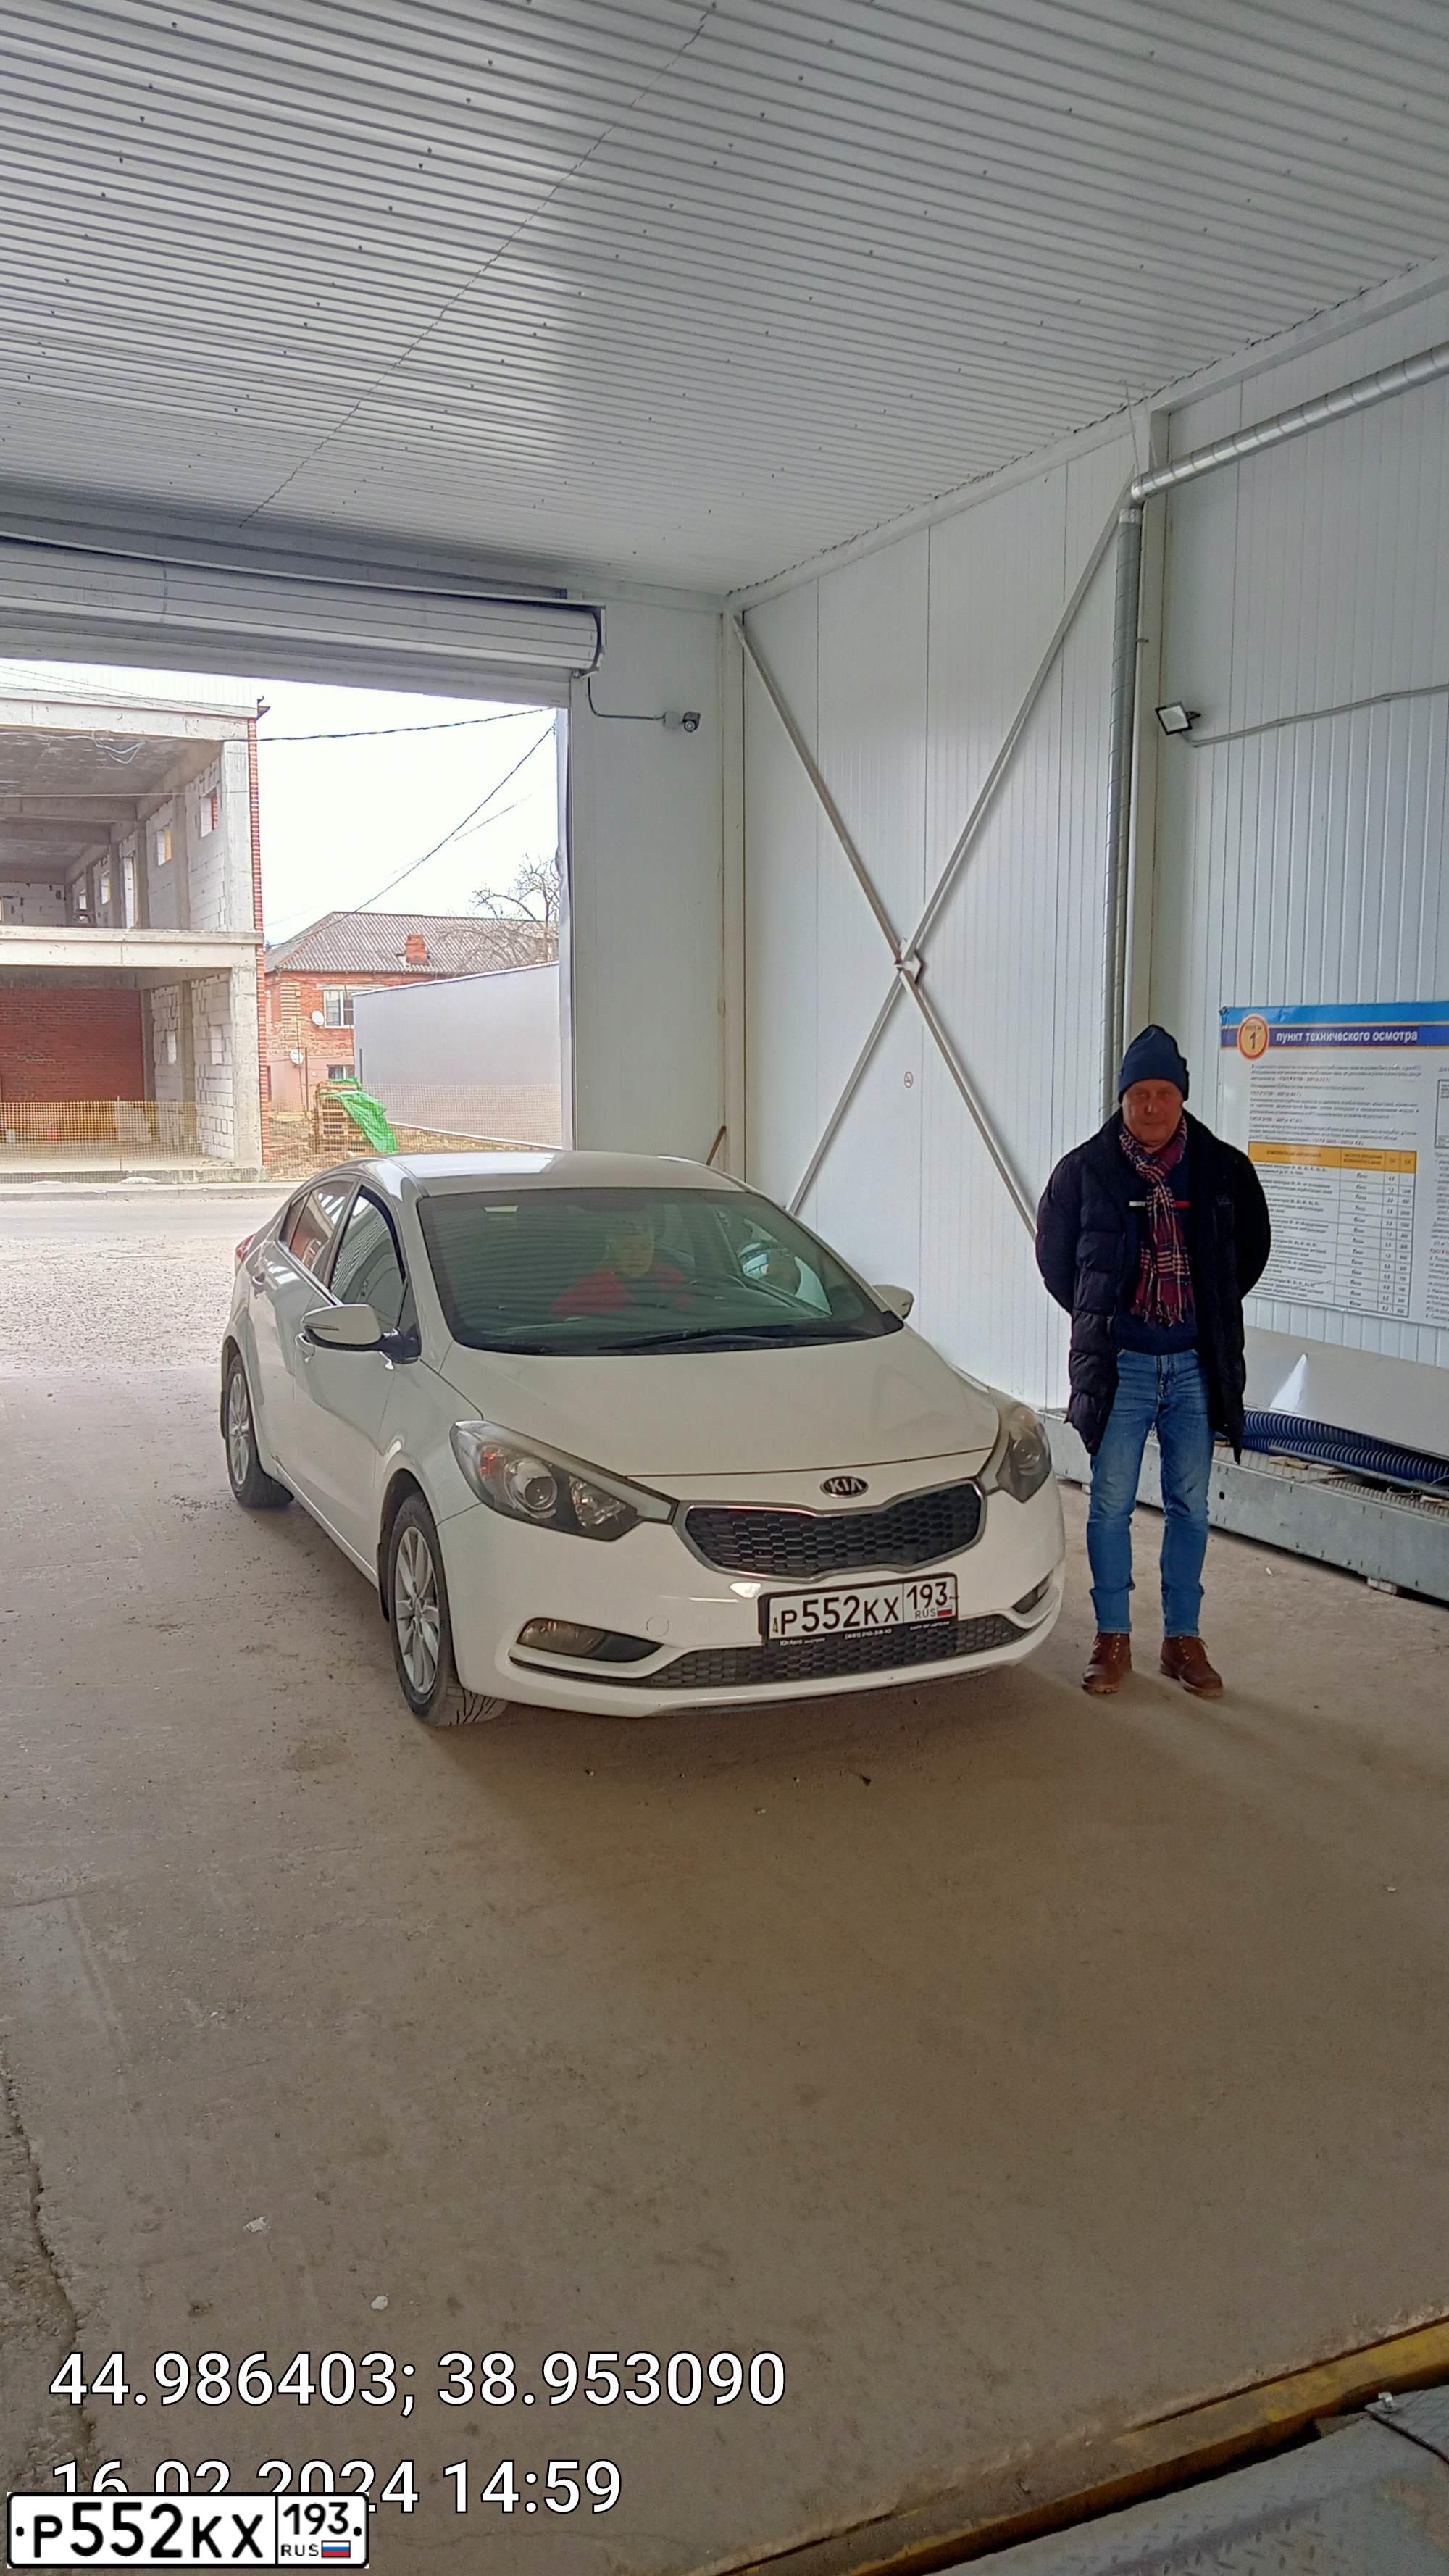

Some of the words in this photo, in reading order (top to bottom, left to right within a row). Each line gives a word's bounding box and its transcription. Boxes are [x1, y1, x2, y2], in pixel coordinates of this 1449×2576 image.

[1249, 1031, 1256, 1050] 1
[1276, 1033, 1303, 1044] пункт
[1305, 1031, 1370, 1042] технического
[1371, 1030, 1418, 1043] осмотра
[828, 1477, 863, 1493] KIA
[906, 1581, 948, 1610] 193
[780, 1595, 899, 1635] Р552КХ
[914, 1608, 936, 1620] RUS
